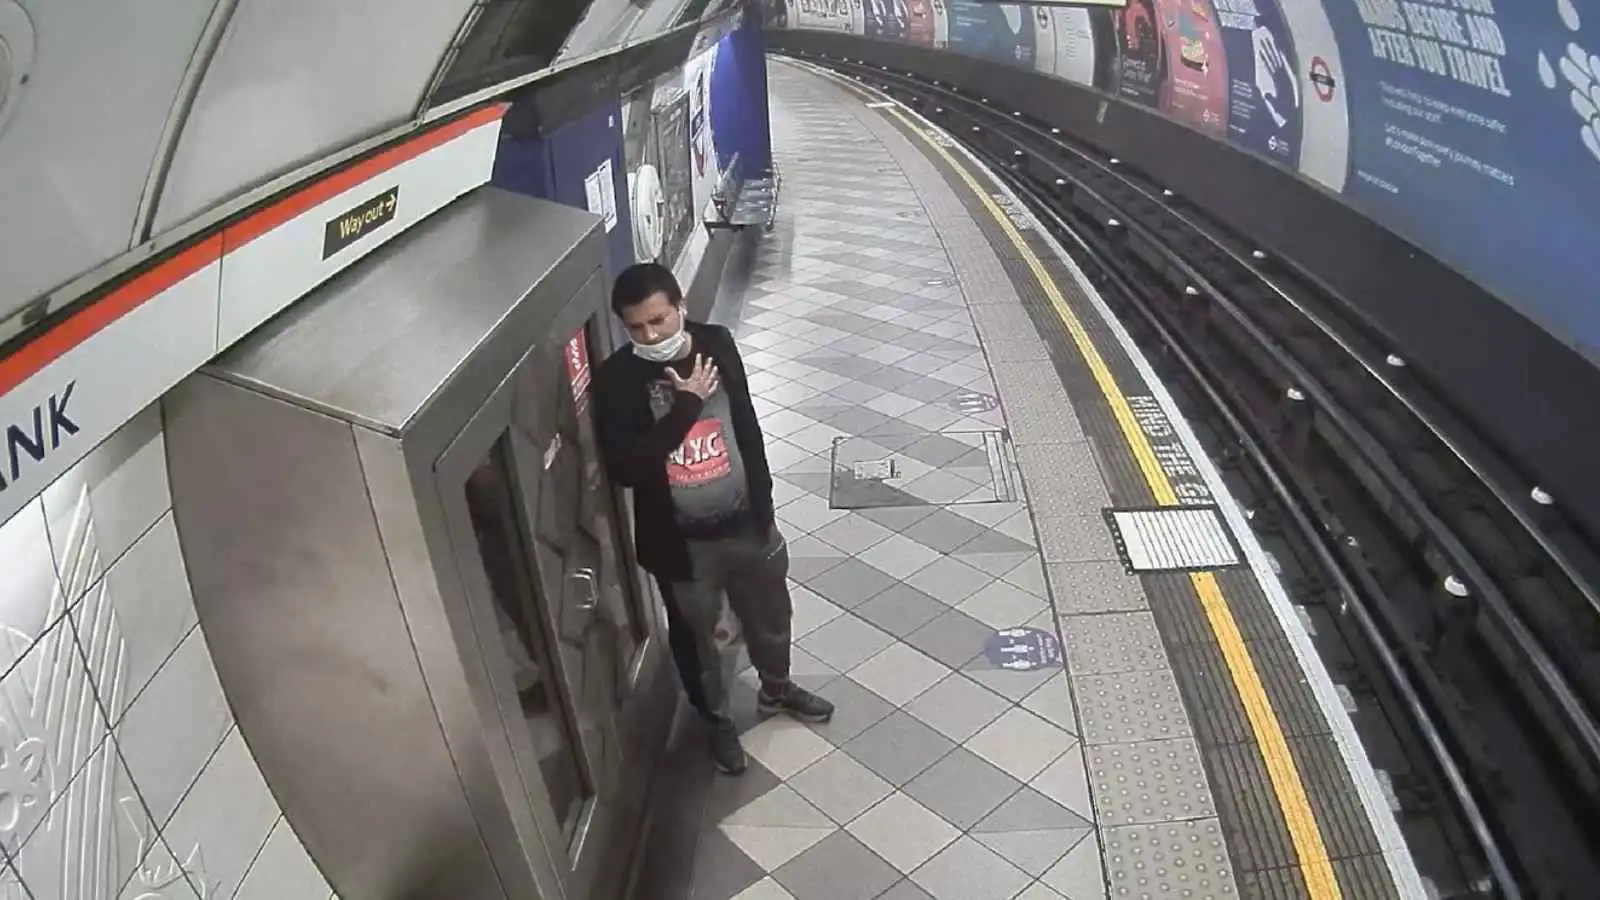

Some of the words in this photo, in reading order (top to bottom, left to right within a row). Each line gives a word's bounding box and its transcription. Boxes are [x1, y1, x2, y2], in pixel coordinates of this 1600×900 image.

[1465, 13, 1507, 56] AND
[1368, 27, 1416, 67] AFTER
[1410, 35, 1448, 76] YOU
[1442, 44, 1512, 98] TRAVEL
[340, 216, 365, 239] Way
[365, 201, 385, 224] out
[1152, 442, 1198, 478] THE
